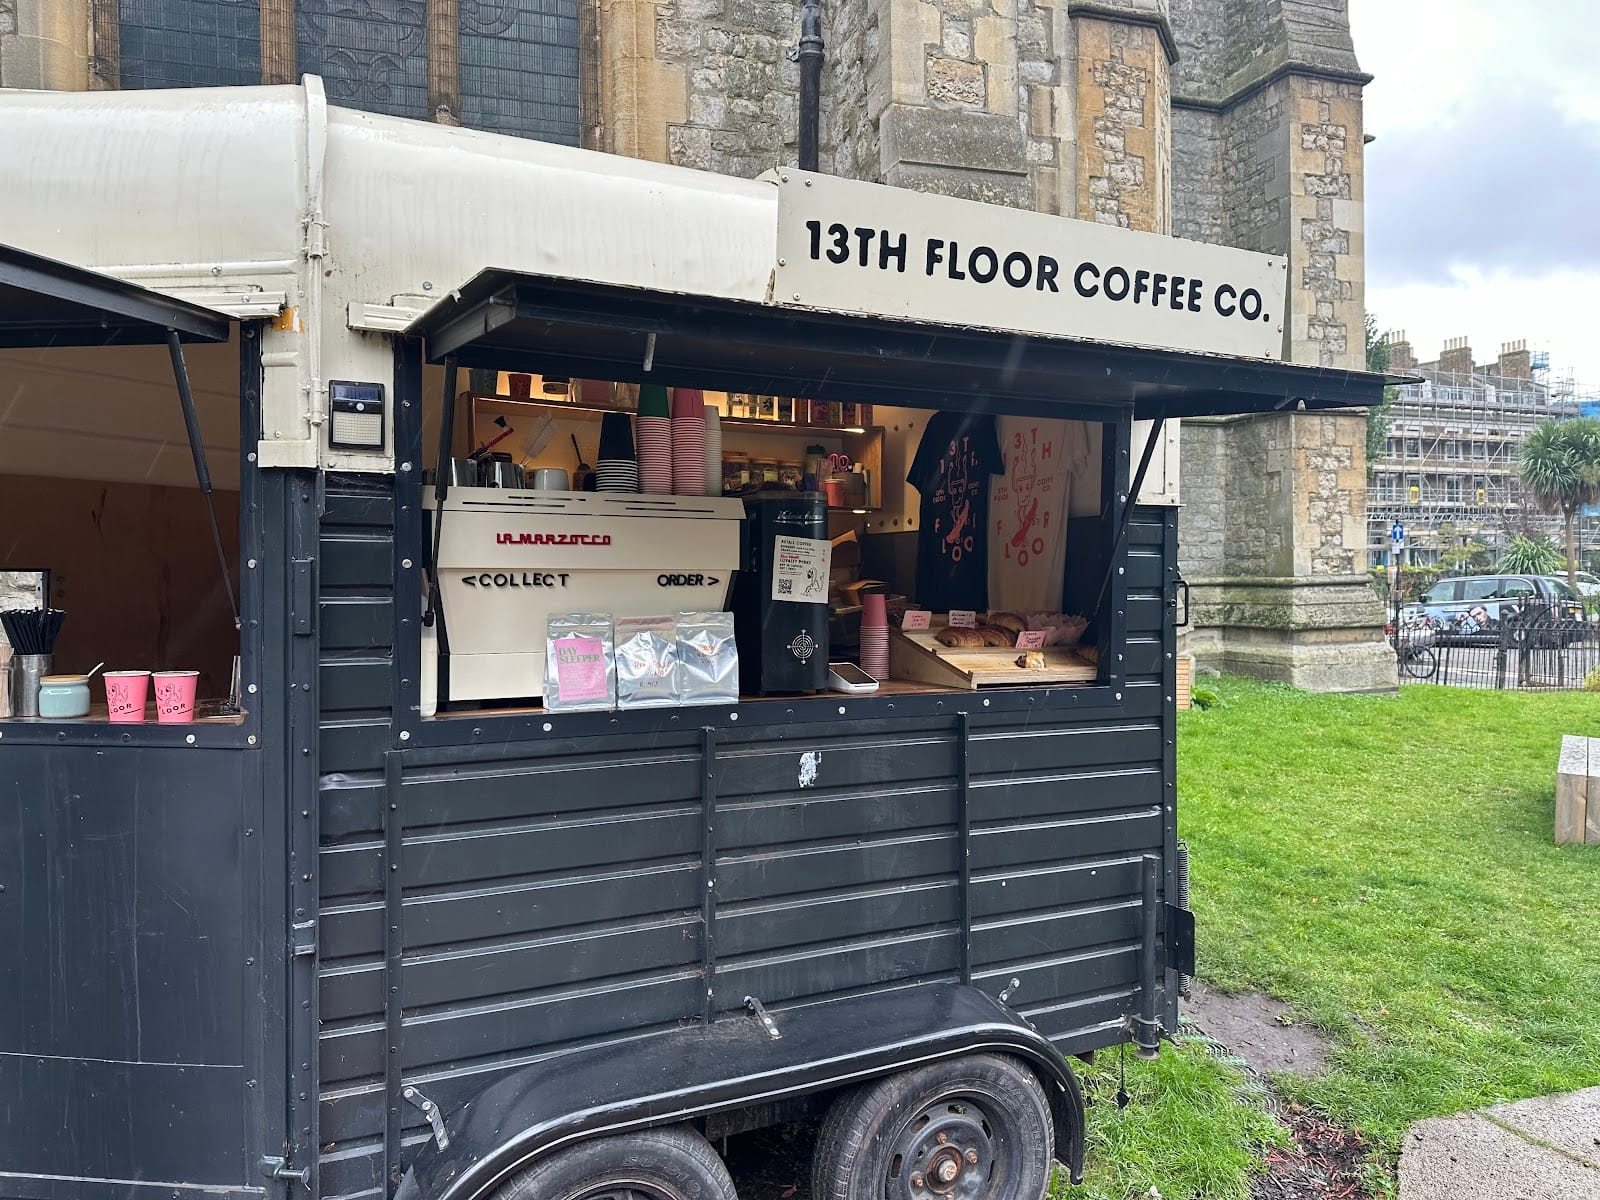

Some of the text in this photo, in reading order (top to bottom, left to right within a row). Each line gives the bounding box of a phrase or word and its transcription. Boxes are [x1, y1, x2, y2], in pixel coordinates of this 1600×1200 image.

[805, 220, 1270, 323] 13TH FLOOR COFFEE CO.
[657, 574, 704, 586] ORDER
[560, 654, 600, 664] SLEEPER
